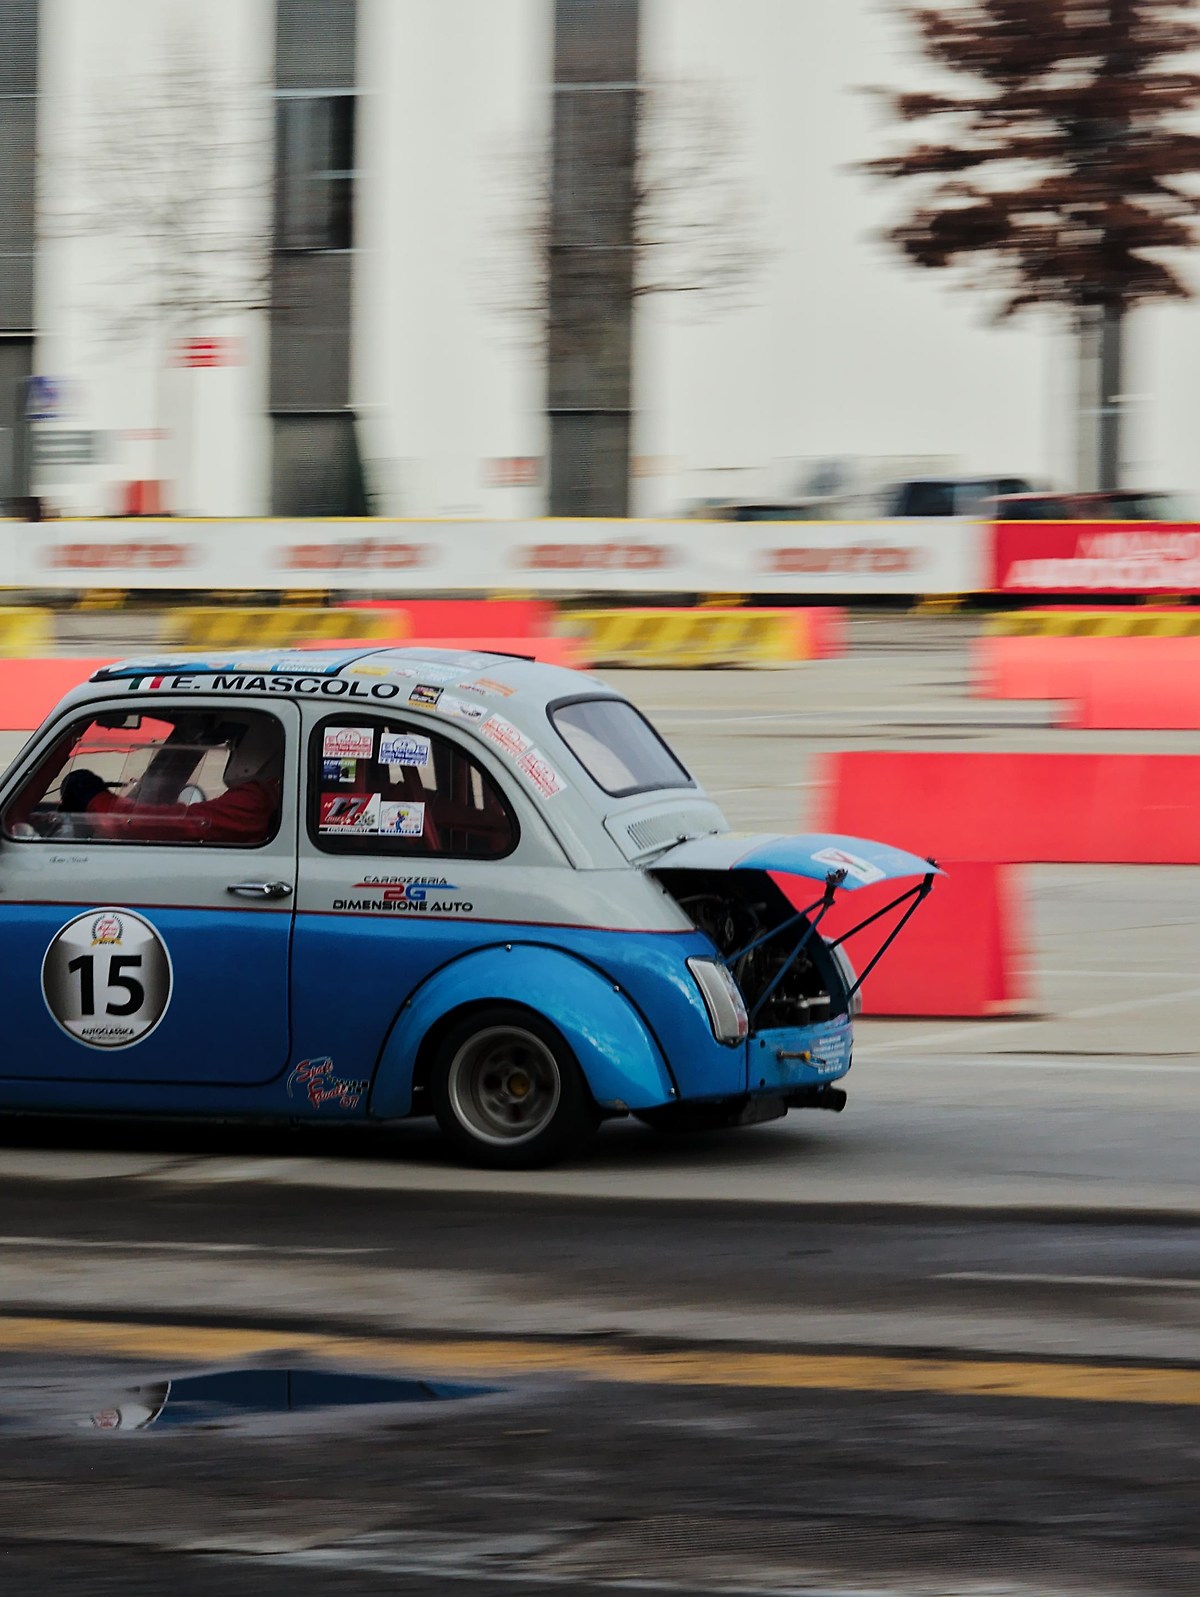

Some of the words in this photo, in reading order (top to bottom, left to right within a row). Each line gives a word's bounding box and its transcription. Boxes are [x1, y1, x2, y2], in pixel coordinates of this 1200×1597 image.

[170, 675, 201, 690] E.
[211, 675, 400, 699] MASCOLO
[363, 875, 448, 885] CARROZZERIA
[383, 883, 427, 901] 2G
[332, 899, 427, 911] DIMENSIONE
[430, 901, 474, 912] AUTO
[68, 955, 145, 1016] 15
